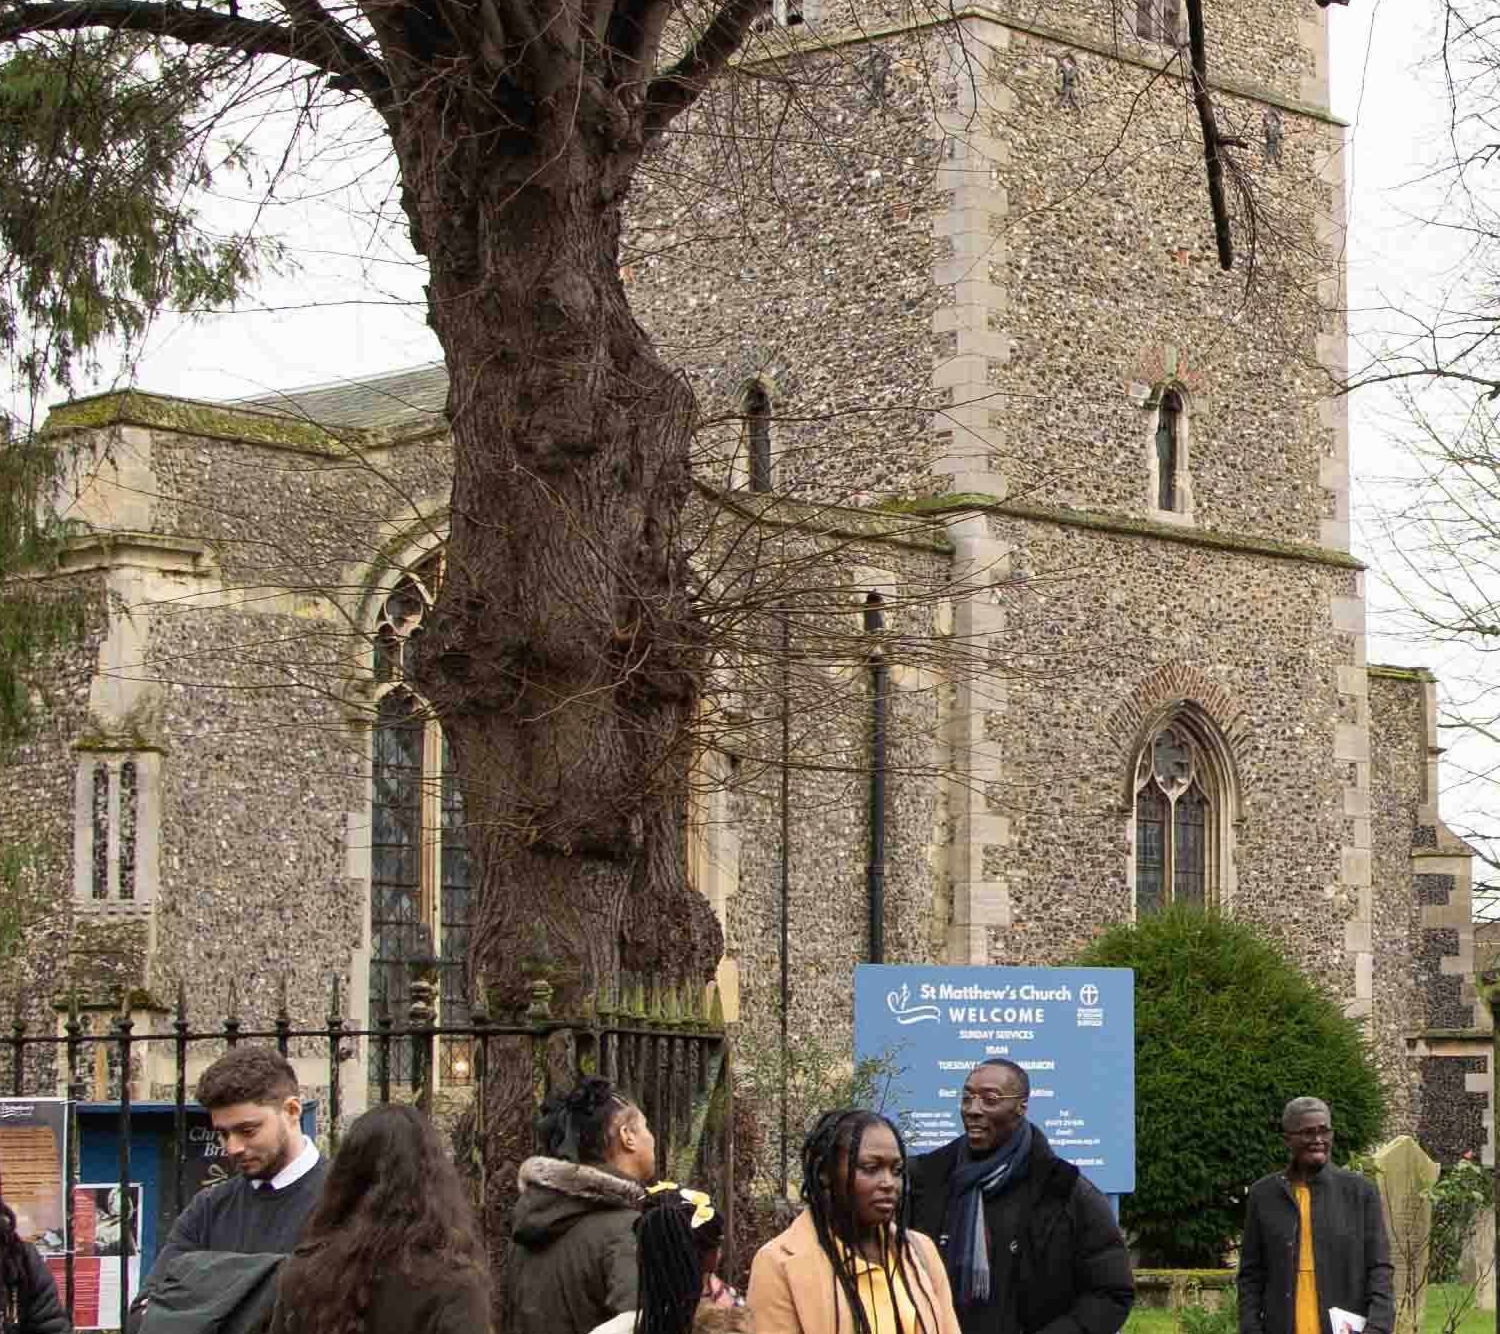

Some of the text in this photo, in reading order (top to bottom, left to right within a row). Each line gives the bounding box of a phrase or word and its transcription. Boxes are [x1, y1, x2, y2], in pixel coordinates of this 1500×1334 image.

[919, 982, 1072, 1002] St Matthew's Church
[948, 1007, 1045, 1023] WELCOME
